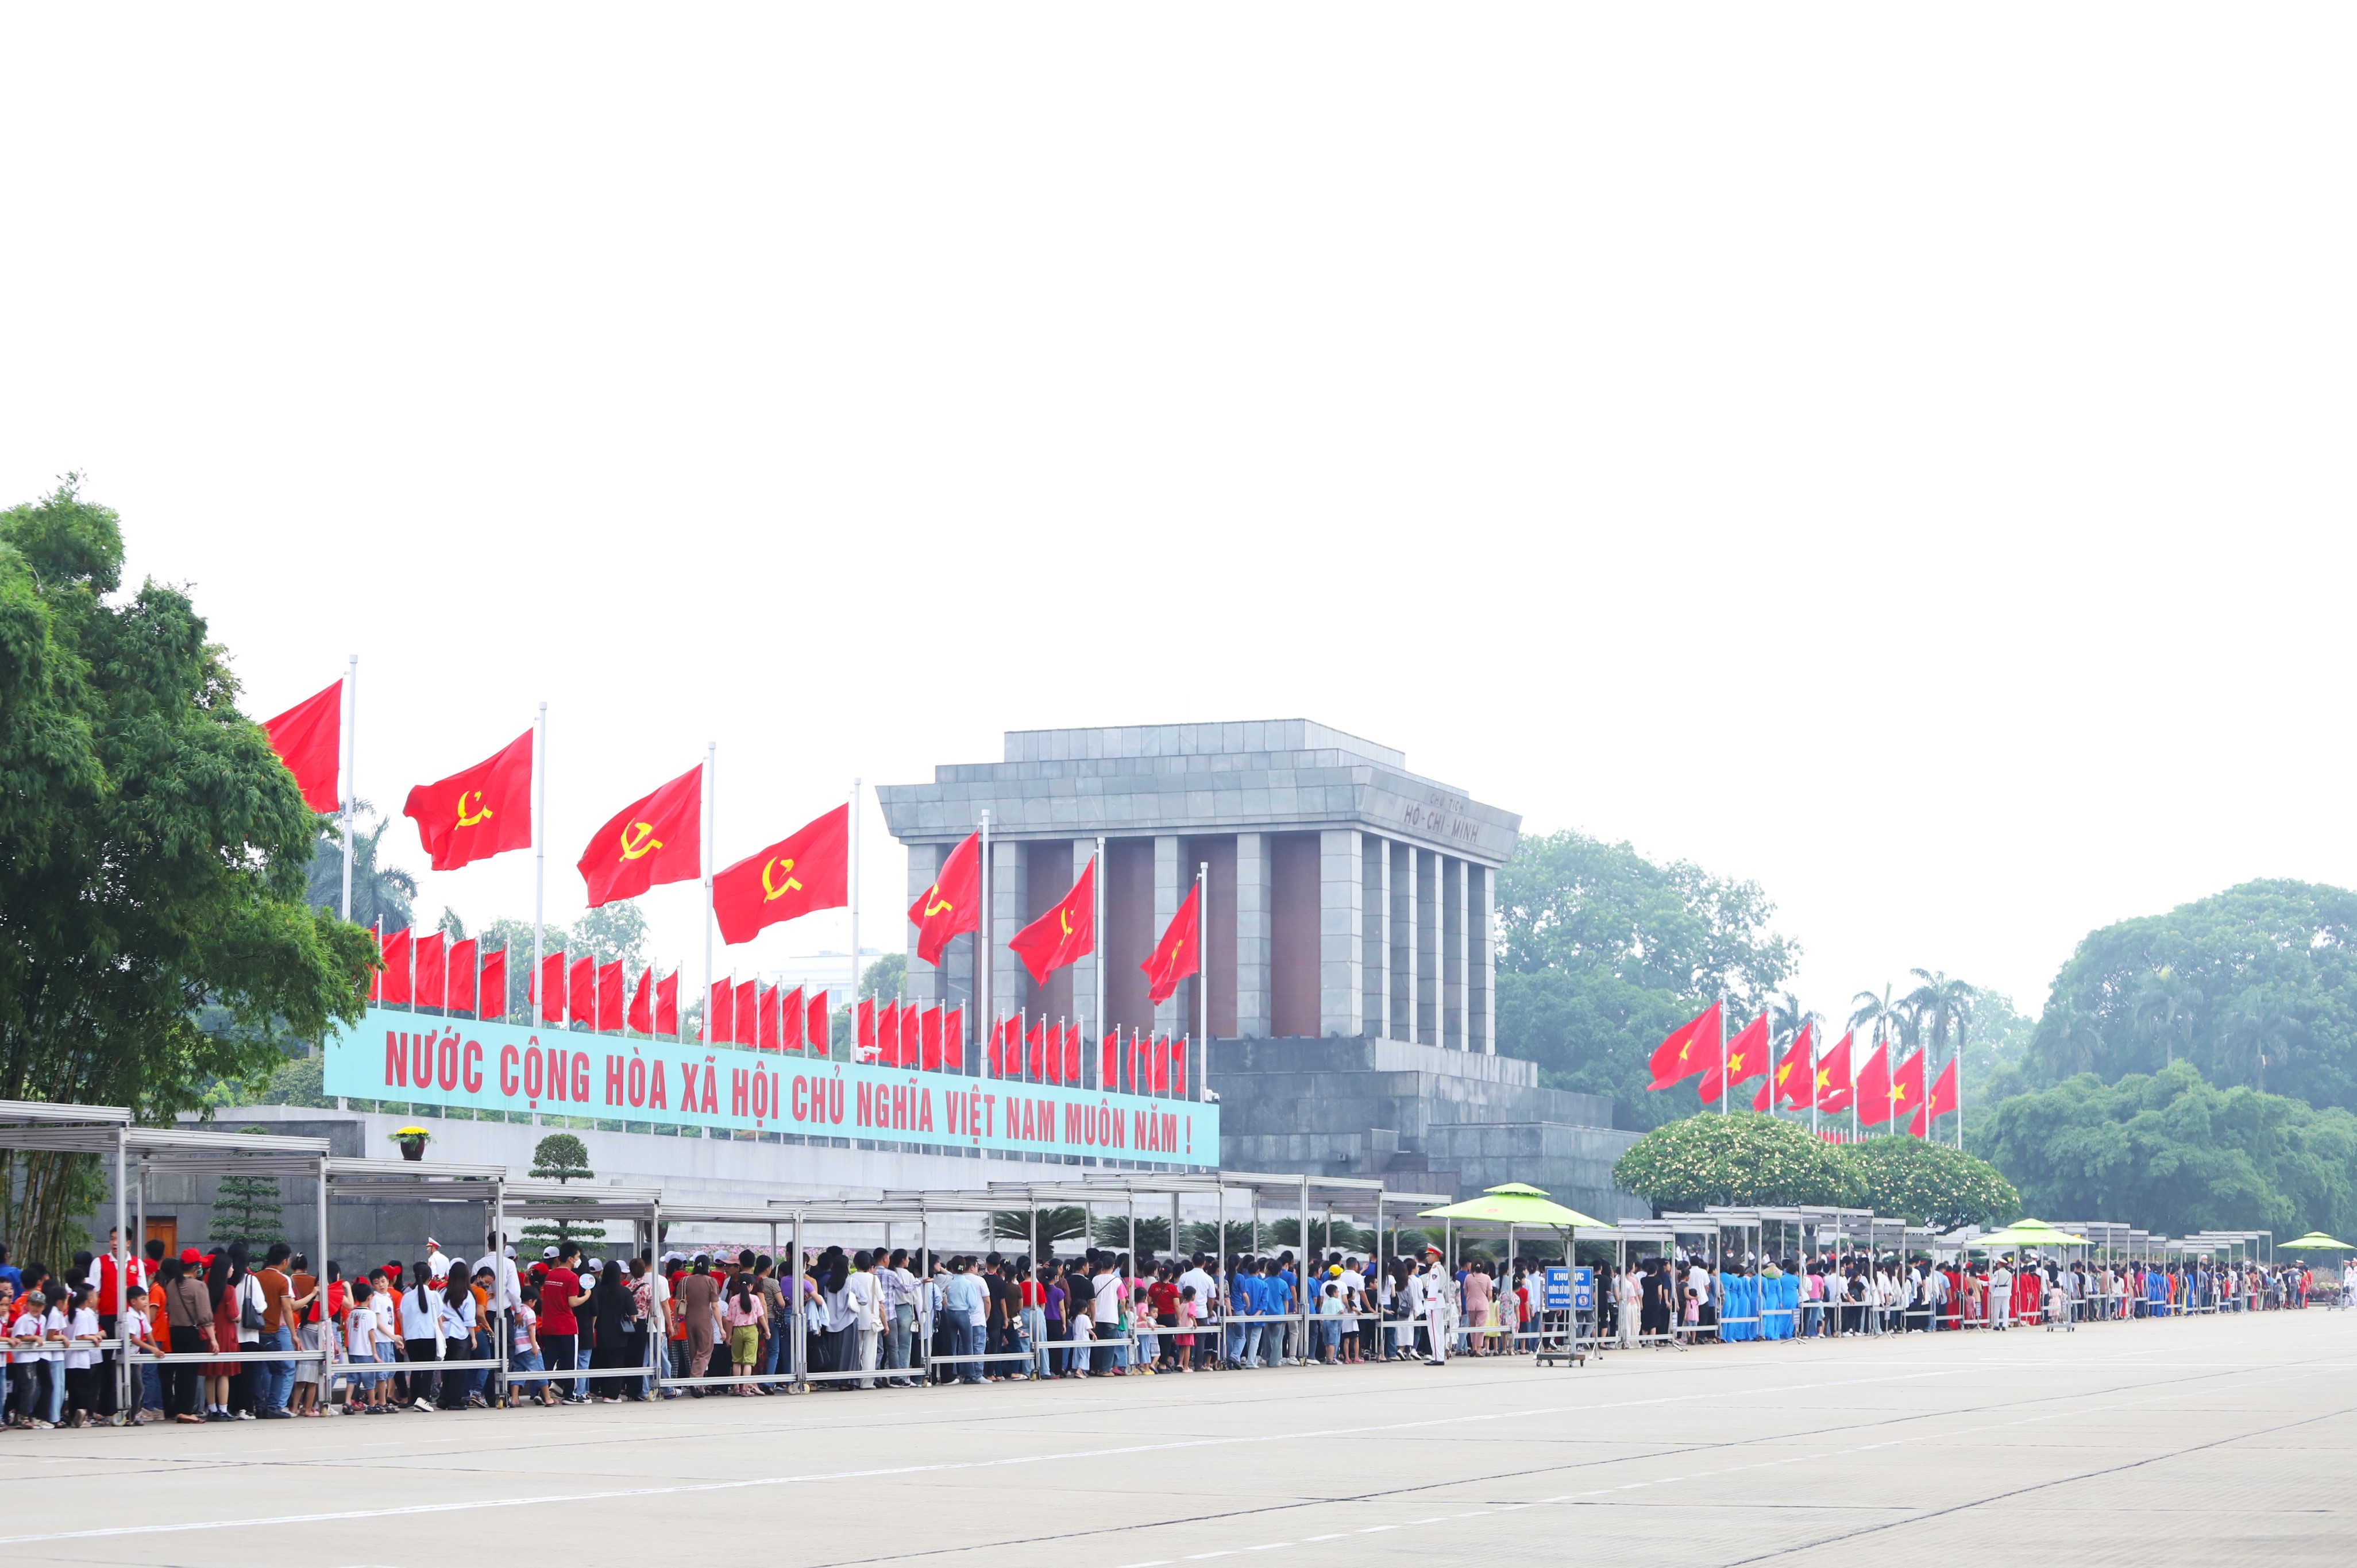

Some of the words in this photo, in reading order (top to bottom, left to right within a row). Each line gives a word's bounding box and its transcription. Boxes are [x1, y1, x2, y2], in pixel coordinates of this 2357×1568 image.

[385, 1026, 483, 1094] NƯỚC
[500, 1036, 590, 1109] CỘNG
[606, 1047, 667, 1110] HÒA
[681, 1056, 719, 1114] XÃ
[732, 1061, 778, 1127] HỘI
[792, 1065, 844, 1125] CHỦ
[857, 1077, 933, 1132] NGHĨA
[946, 1084, 996, 1144] VIỆT
[1006, 1097, 1055, 1142] NAM
[1066, 1098, 1125, 1148] MUÔN
[1135, 1102, 1177, 1153] NĂM
[1554, 1272, 1568, 1281] KHU
[1574, 1272, 1584, 1283] ỰC
